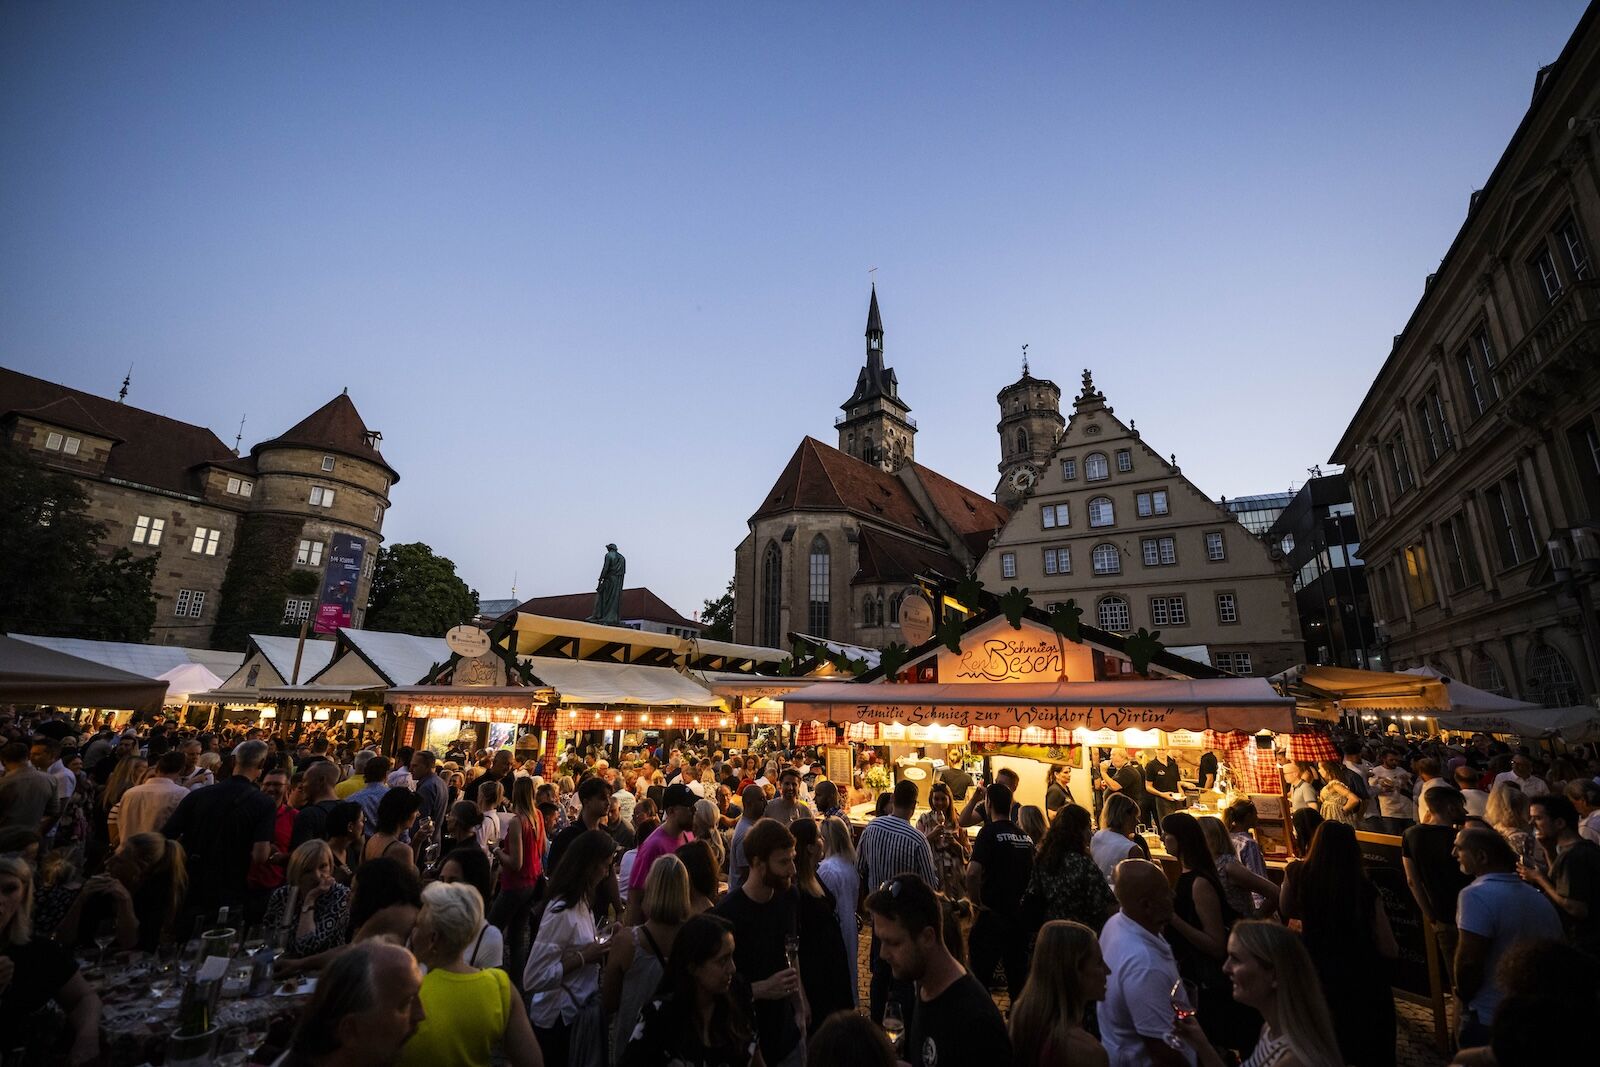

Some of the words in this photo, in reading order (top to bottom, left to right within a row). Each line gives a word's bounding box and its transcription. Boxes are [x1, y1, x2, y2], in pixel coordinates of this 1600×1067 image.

[983, 639, 1063, 677] Besen
[1003, 641, 1060, 658] Schmiegs
[856, 705, 905, 719] Familie
[907, 706, 969, 725] Schmieg
[974, 709, 1001, 721] zur
[1006, 706, 1094, 728] "Weindorf
[1100, 706, 1174, 726] Wirtin"
